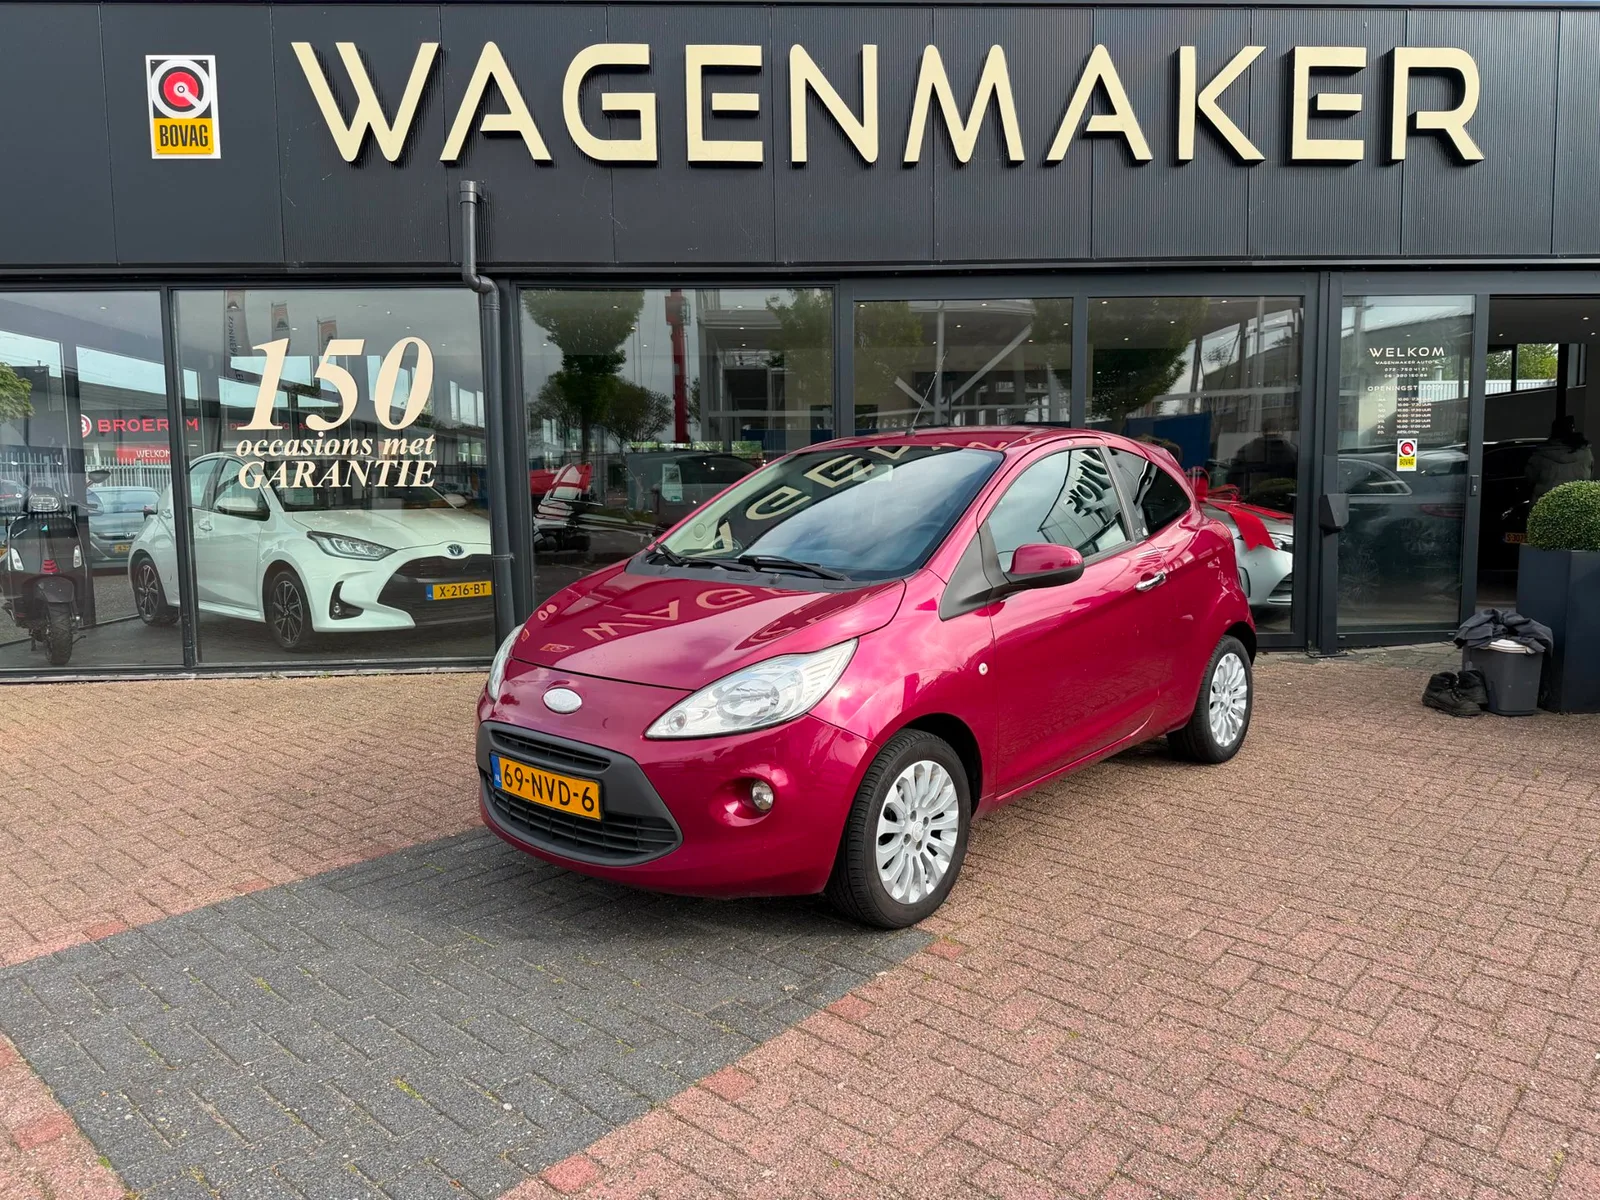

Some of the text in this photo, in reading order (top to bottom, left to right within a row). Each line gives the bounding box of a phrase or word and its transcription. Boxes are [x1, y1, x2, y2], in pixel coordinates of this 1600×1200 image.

[292, 41, 1484, 163] WAGENMAKER
[158, 124, 209, 148] BOVAG
[1369, 346, 1445, 358] WELKOM
[236, 336, 435, 431] 150
[97, 418, 199, 432] BROERM
[235, 430, 436, 457] occasions met
[236, 459, 438, 490] GARANTIE
[439, 583, 487, 598] X-216-BT
[503, 763, 595, 813] 69-NVD-6
